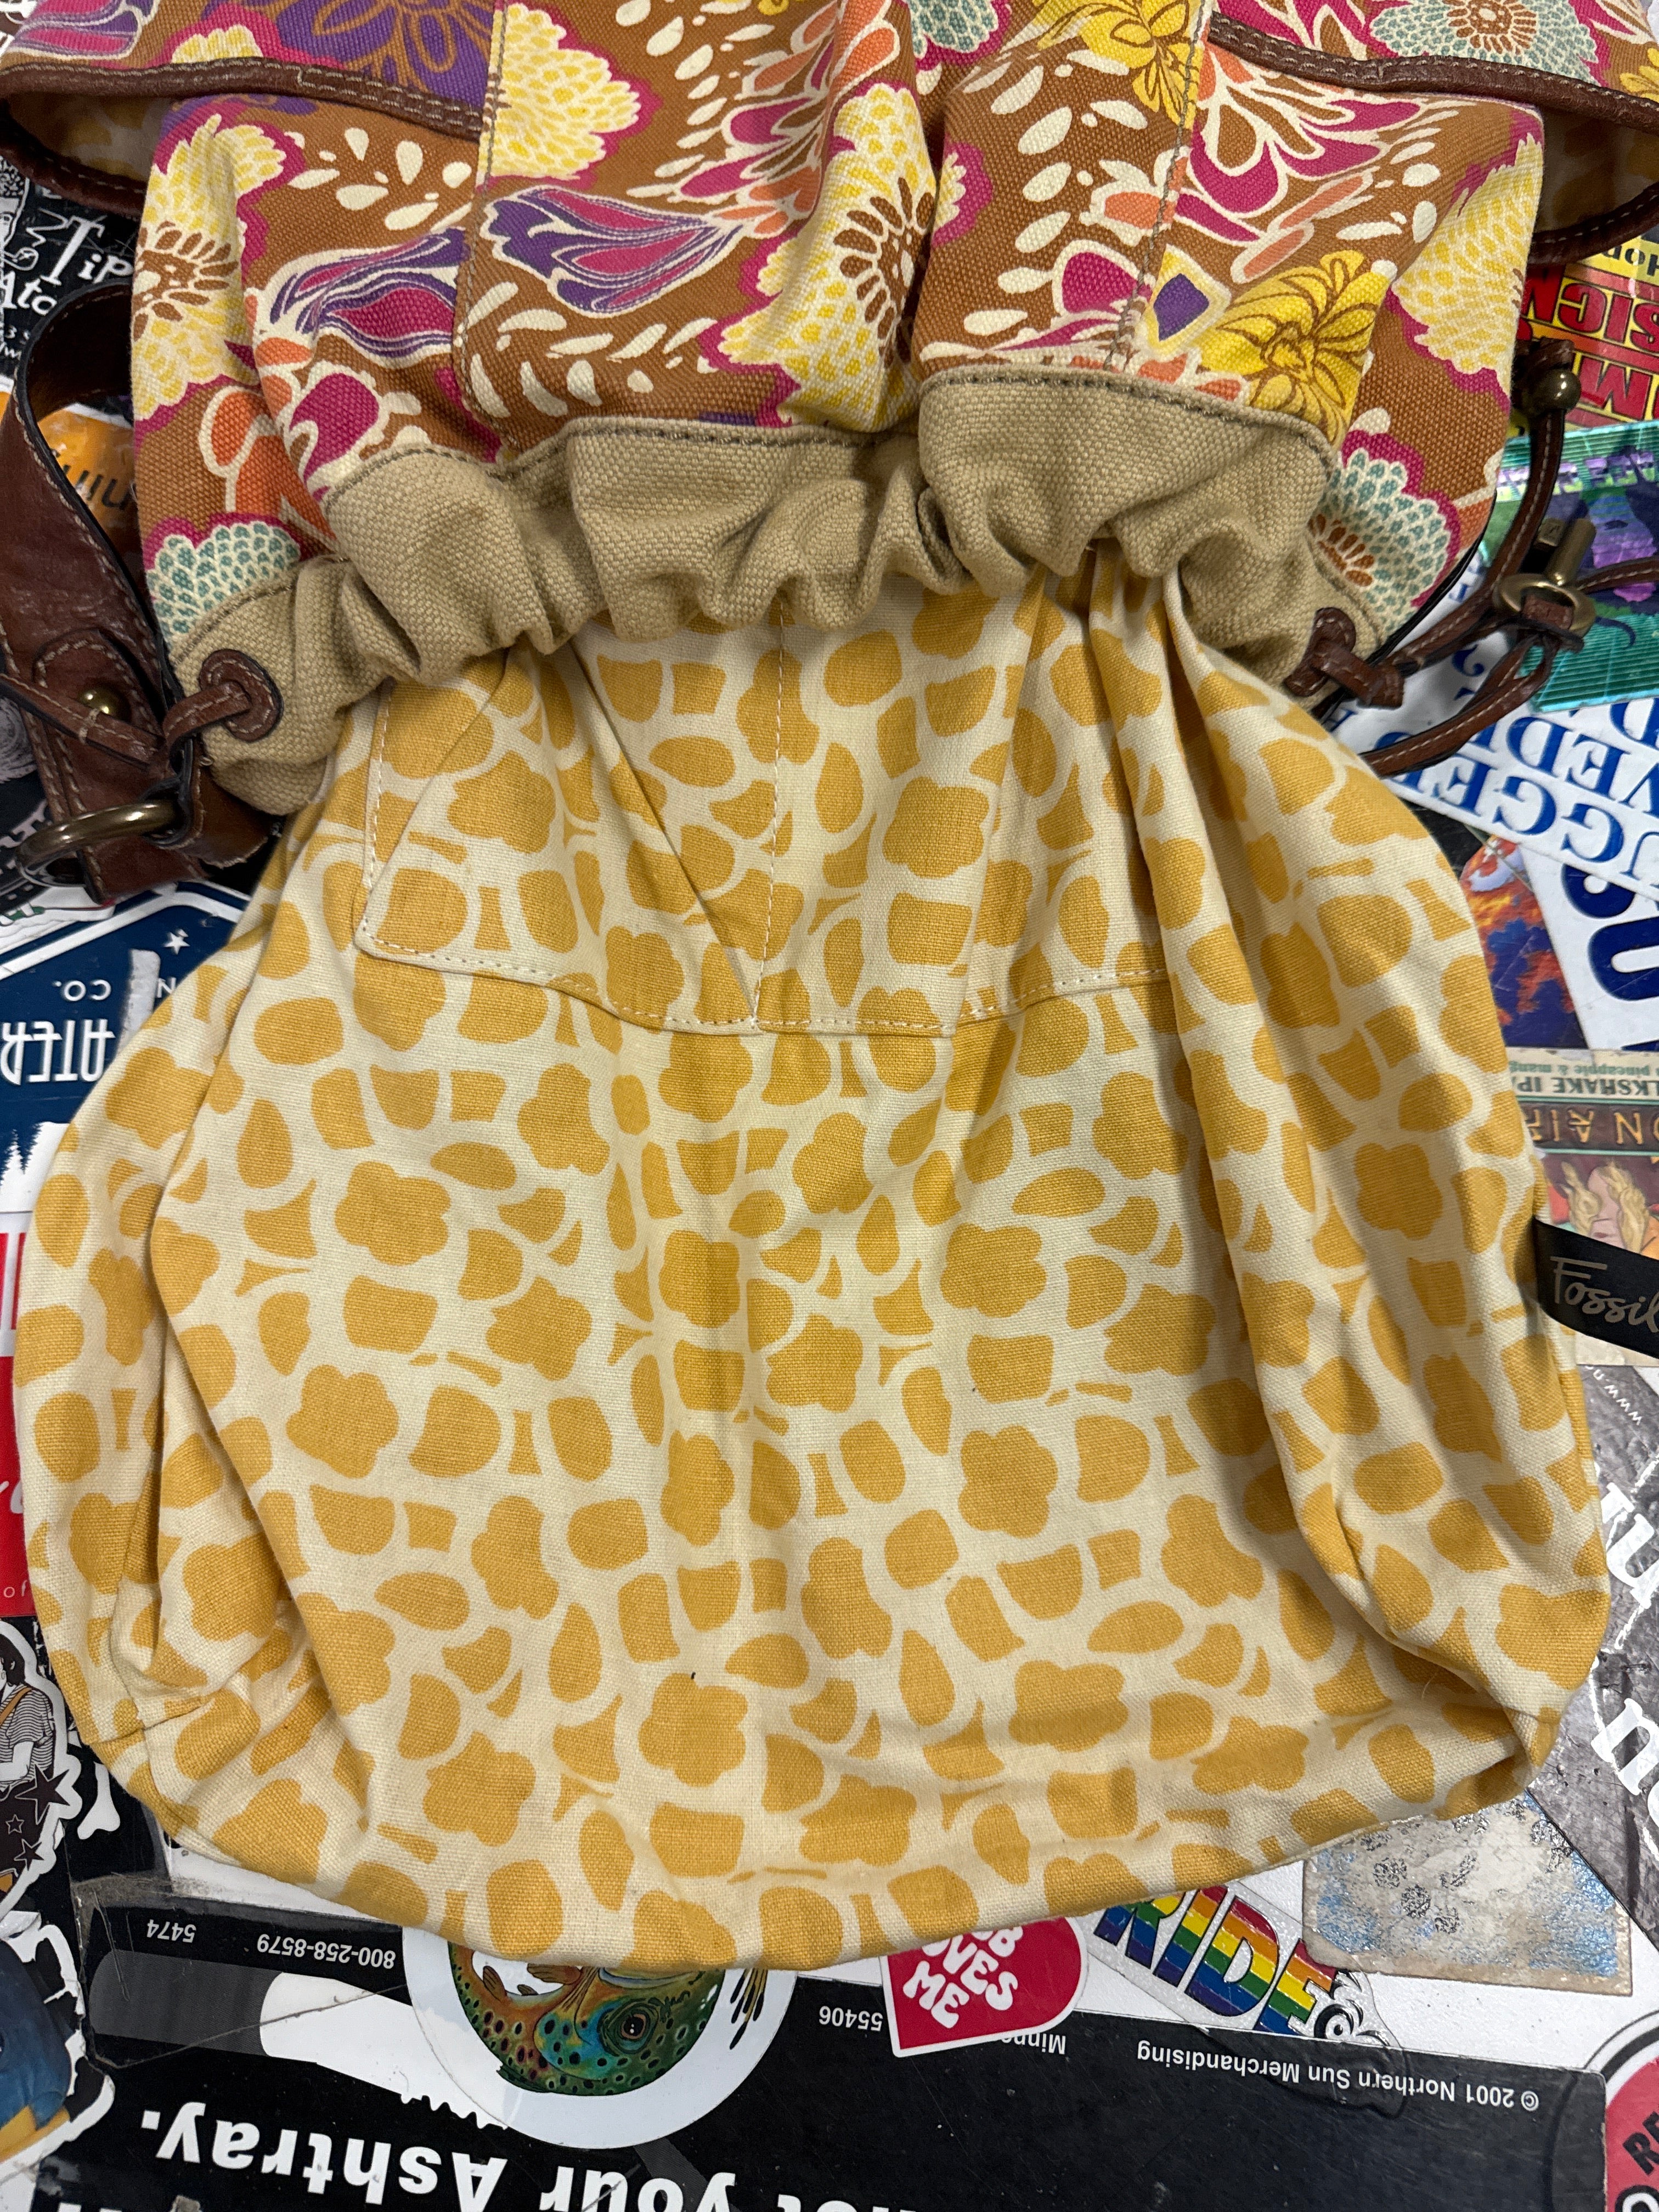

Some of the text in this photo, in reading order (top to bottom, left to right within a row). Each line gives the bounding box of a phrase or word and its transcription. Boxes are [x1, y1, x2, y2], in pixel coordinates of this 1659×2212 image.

[54, 979, 111, 1001] CO.
[1511, 1076, 1542, 1092] IP
[1550, 1256, 1659, 1333] Fossil
[146, 1918, 197, 1943] 5474
[256, 1933, 396, 1970] 800-258-8579
[902, 1960, 970, 2029] ME
[819, 2005, 883, 2032] 55406
[1137, 2039, 1300, 2083] Merchandising
[1308, 2066, 1350, 2090] Sun
[1358, 2070, 1455, 2103] Northern
[1465, 2083, 1515, 2109] 2001
[141, 2101, 507, 2212] Ashtray.
